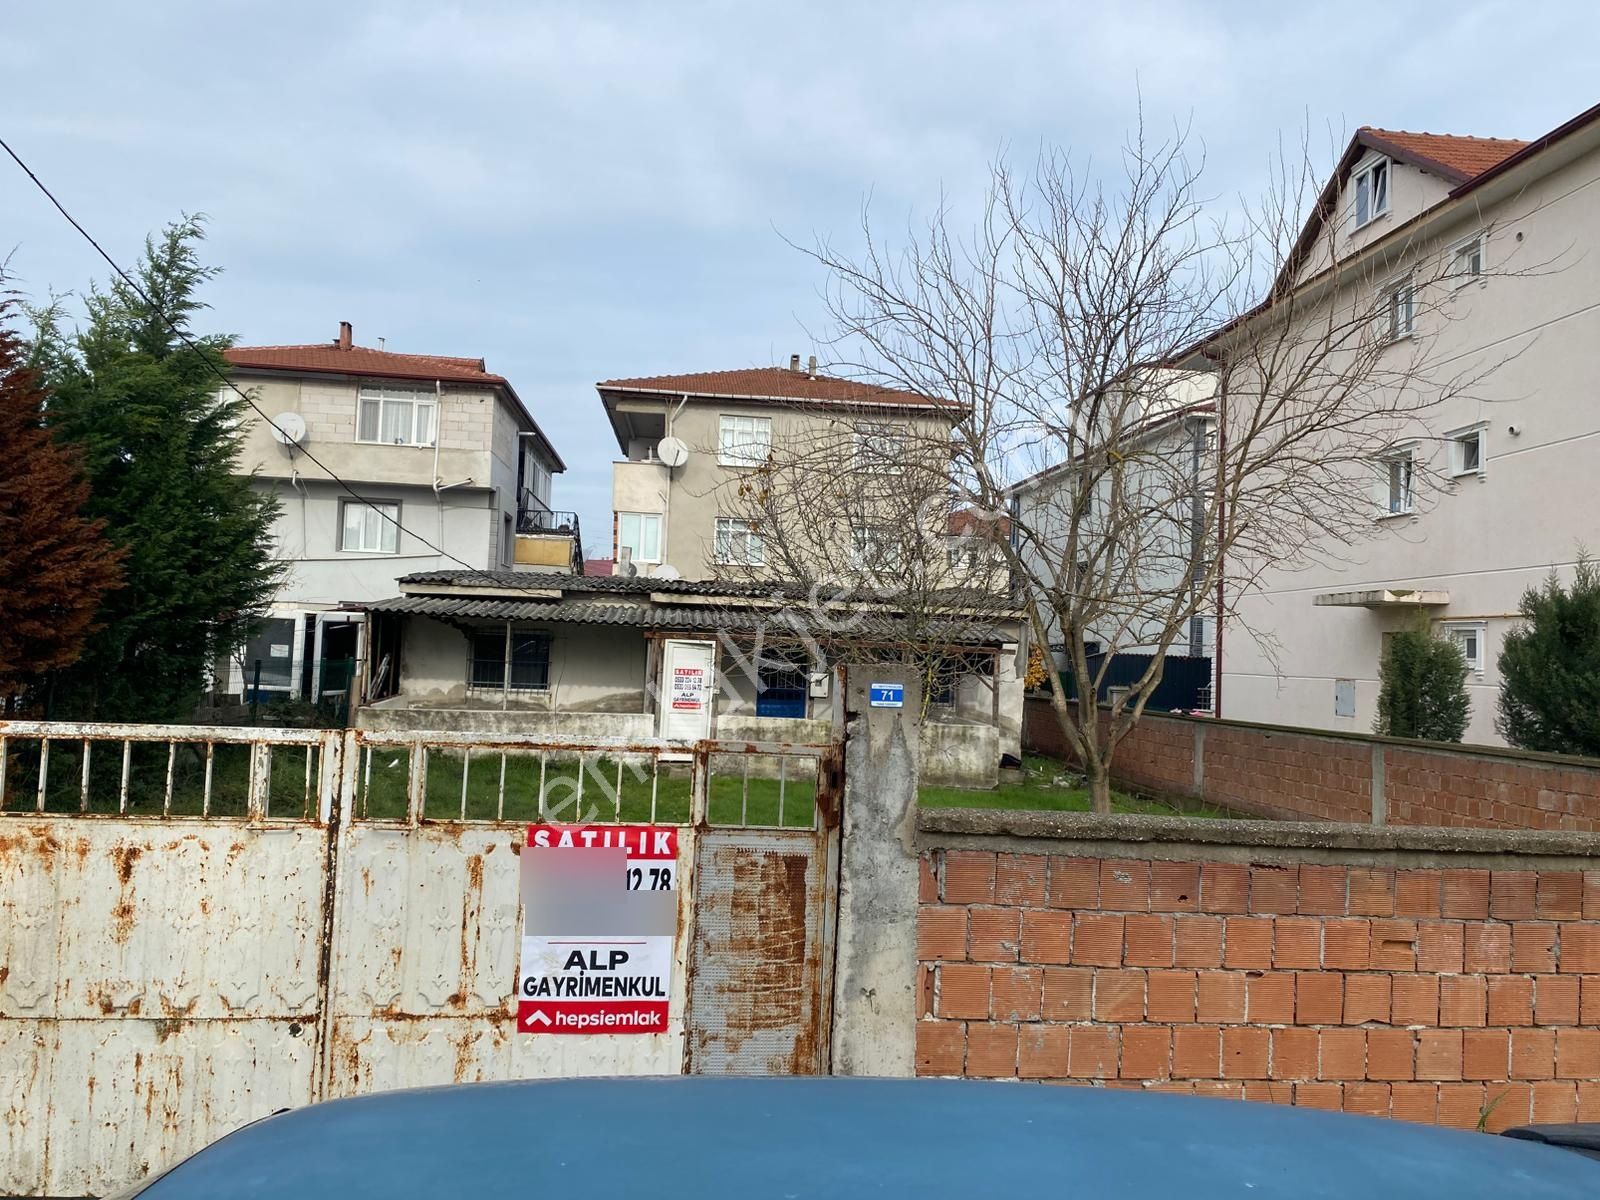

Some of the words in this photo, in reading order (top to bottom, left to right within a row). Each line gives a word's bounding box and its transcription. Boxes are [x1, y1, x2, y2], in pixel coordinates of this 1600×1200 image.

[881, 690, 894, 701] 71
[534, 829, 671, 854] SATILIK
[563, 950, 629, 970] ALP
[523, 971, 665, 997] GAYRİMENKUL
[555, 1010, 661, 1029] hepsiemlak
